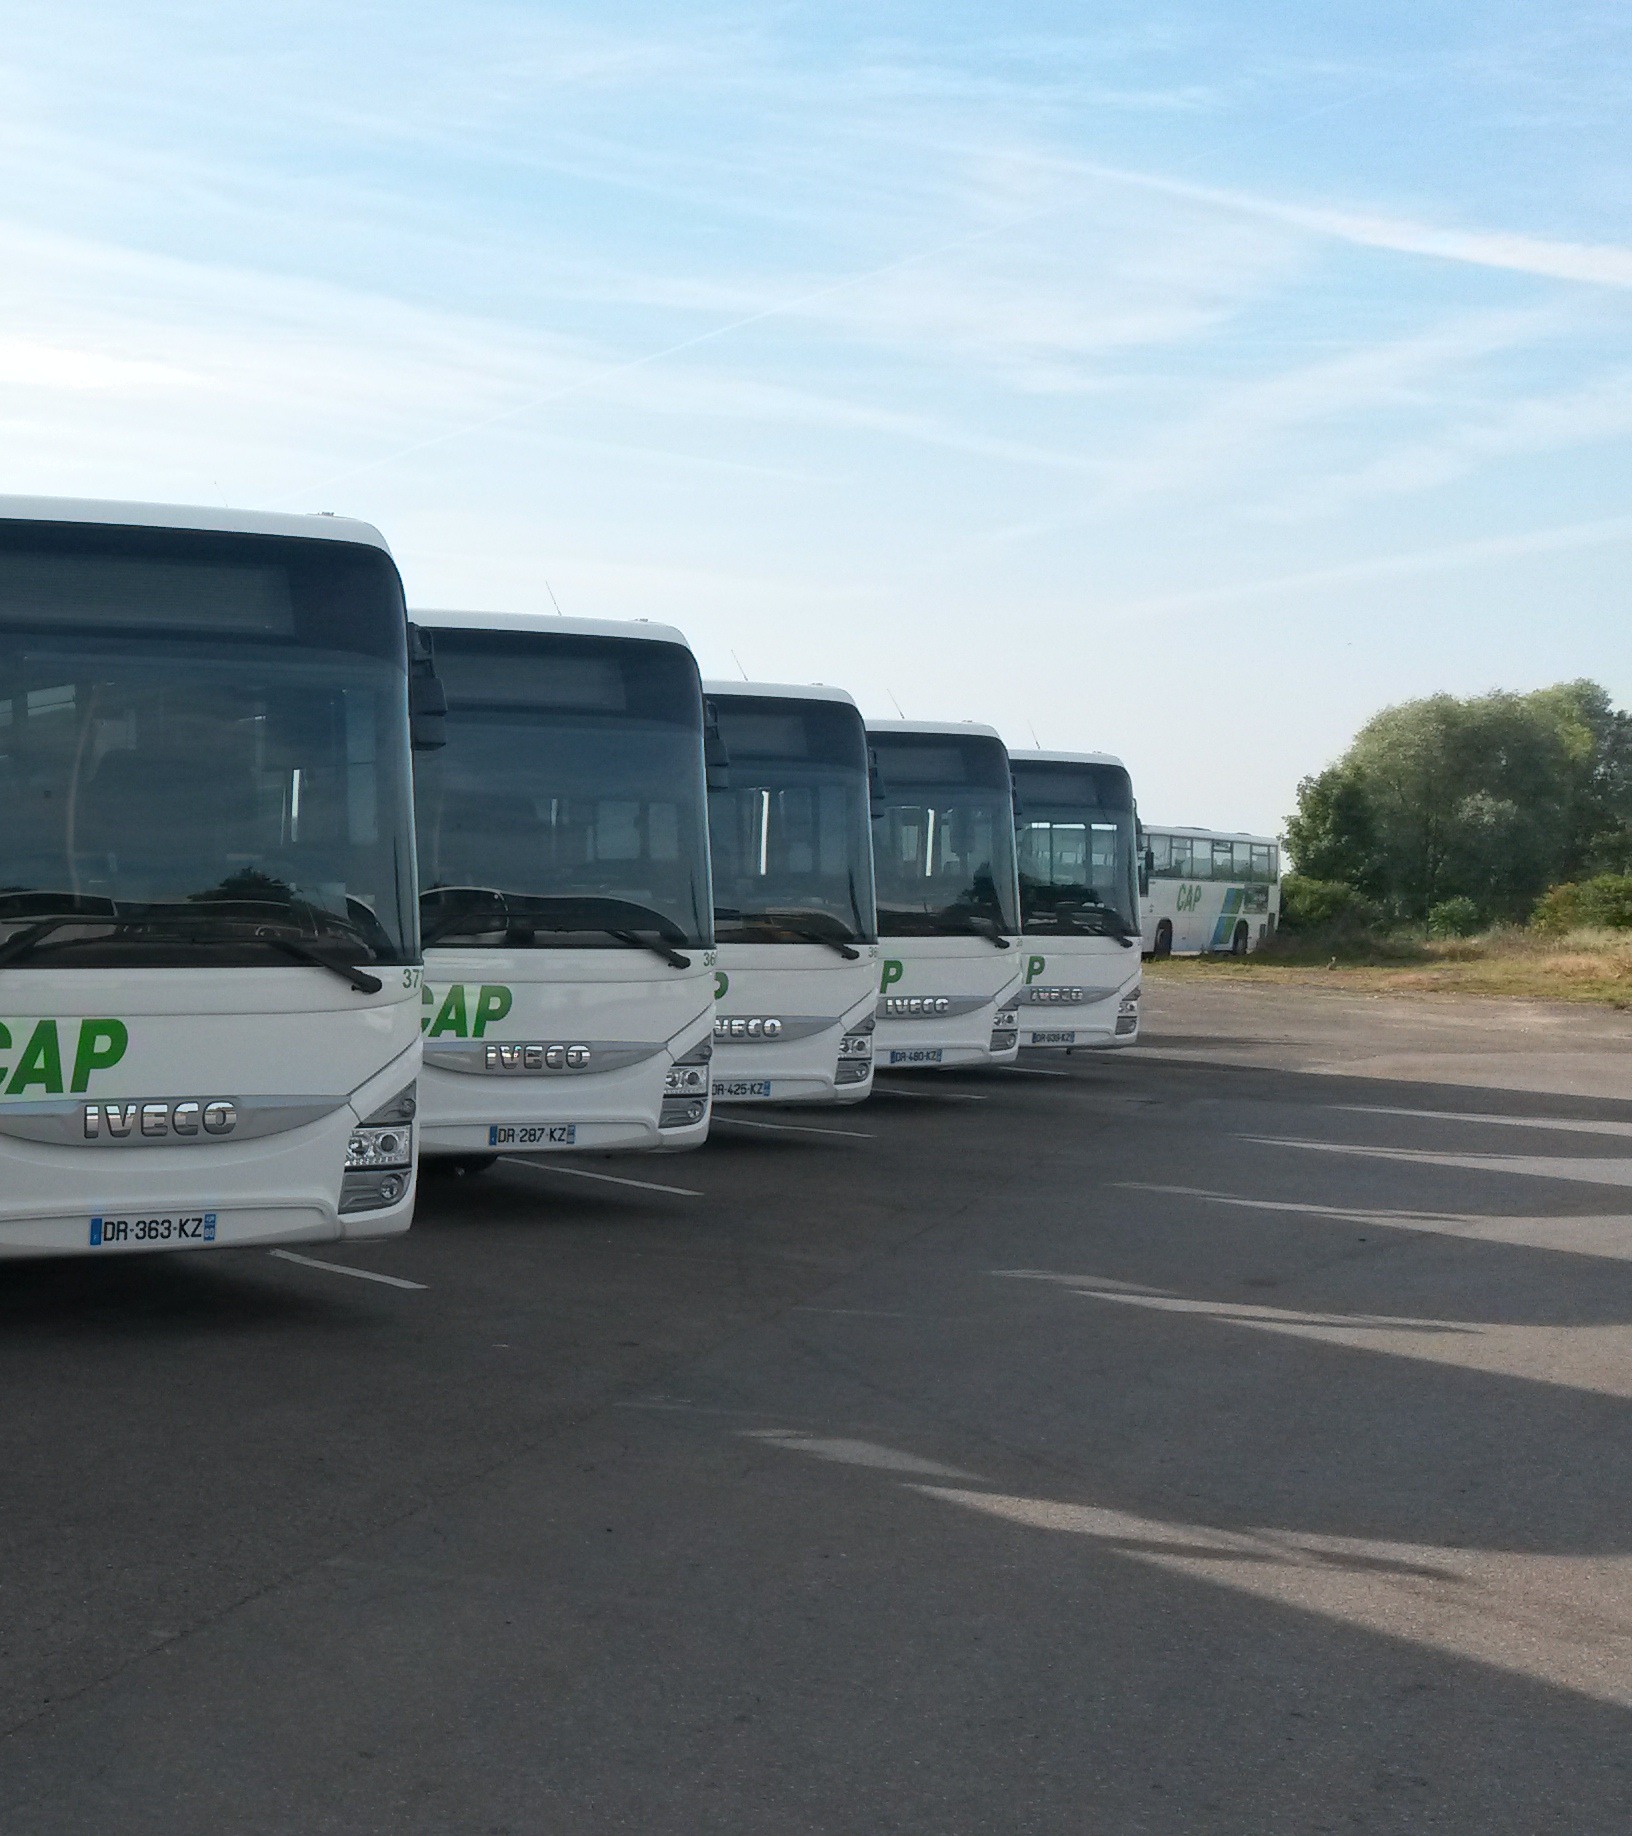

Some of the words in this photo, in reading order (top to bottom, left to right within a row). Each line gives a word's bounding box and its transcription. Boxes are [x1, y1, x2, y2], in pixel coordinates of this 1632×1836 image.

[1176, 883, 1202, 912] CAP
[703, 951, 717, 967] 36
[1030, 987, 1084, 1002] IVECO
[886, 997, 949, 1015] IVECO
[713, 1018, 783, 1038] VECO
[485, 1044, 591, 1070] IVECO
[83, 1100, 238, 1139] IVECO
[498, 1127, 566, 1143] DR-287-KZ
[103, 1217, 203, 1242] DR-363-KZ
